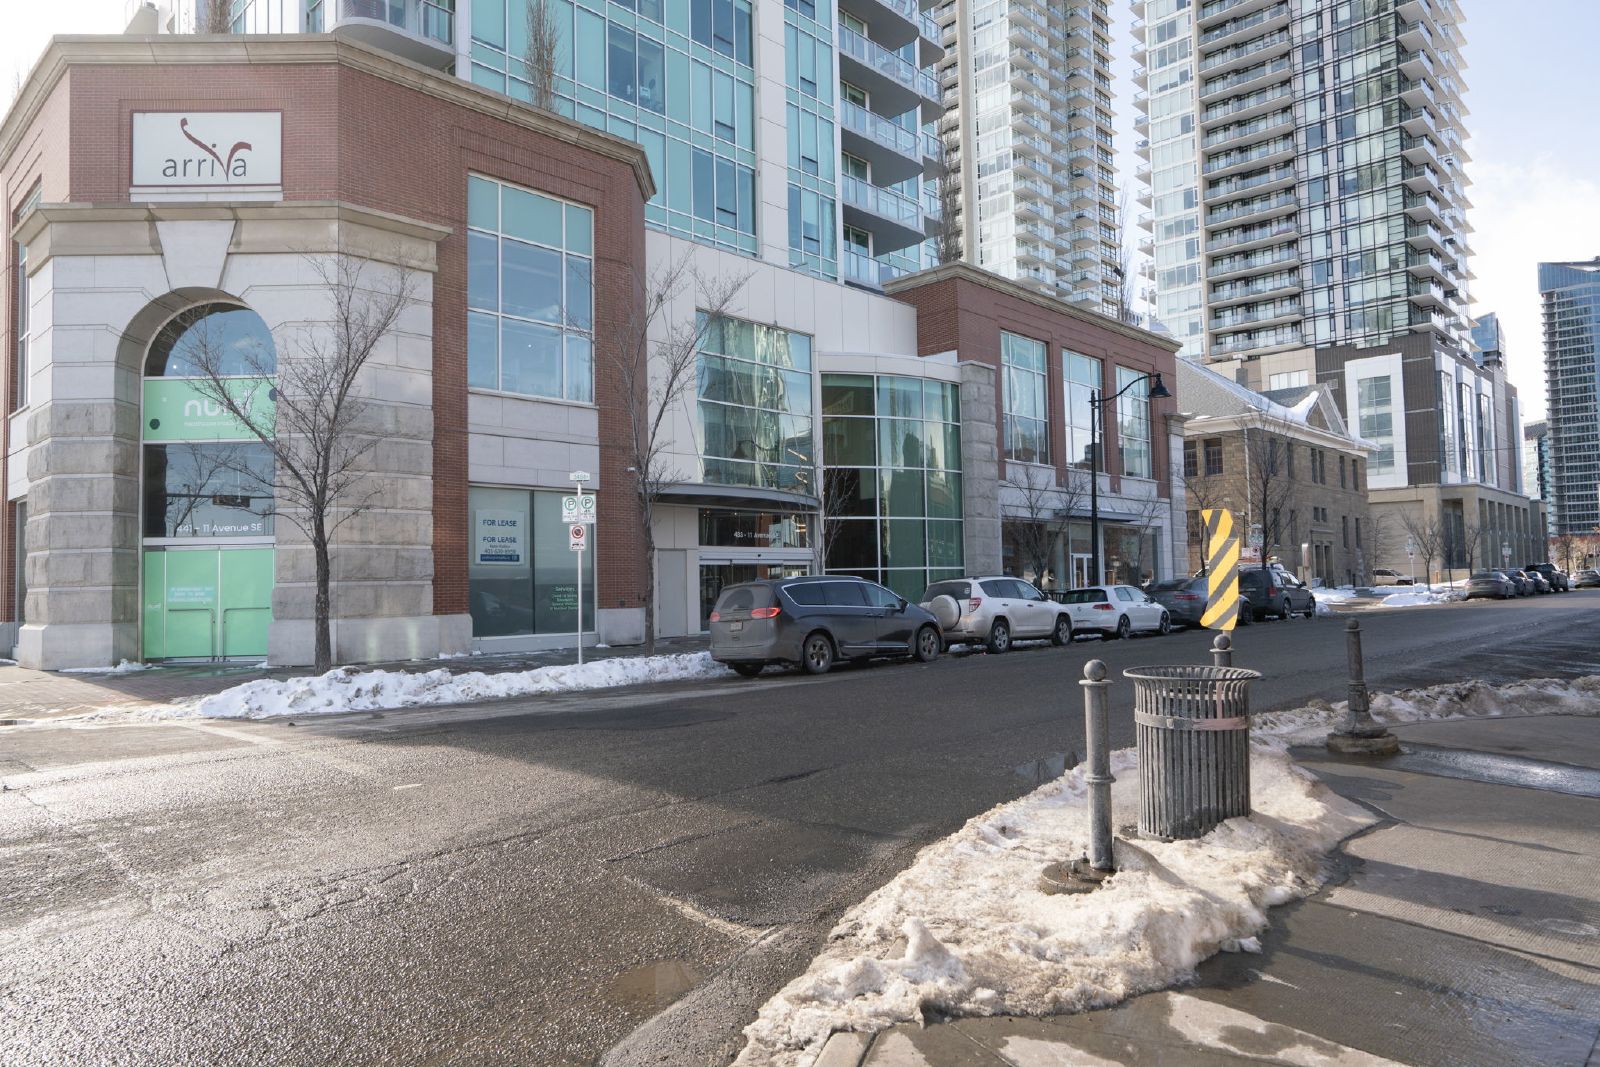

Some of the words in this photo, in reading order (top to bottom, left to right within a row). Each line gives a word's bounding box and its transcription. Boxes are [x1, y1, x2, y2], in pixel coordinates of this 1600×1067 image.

[162, 117, 252, 182] arriva
[212, 523, 249, 532] Avenue
[251, 523, 262, 531] SE
